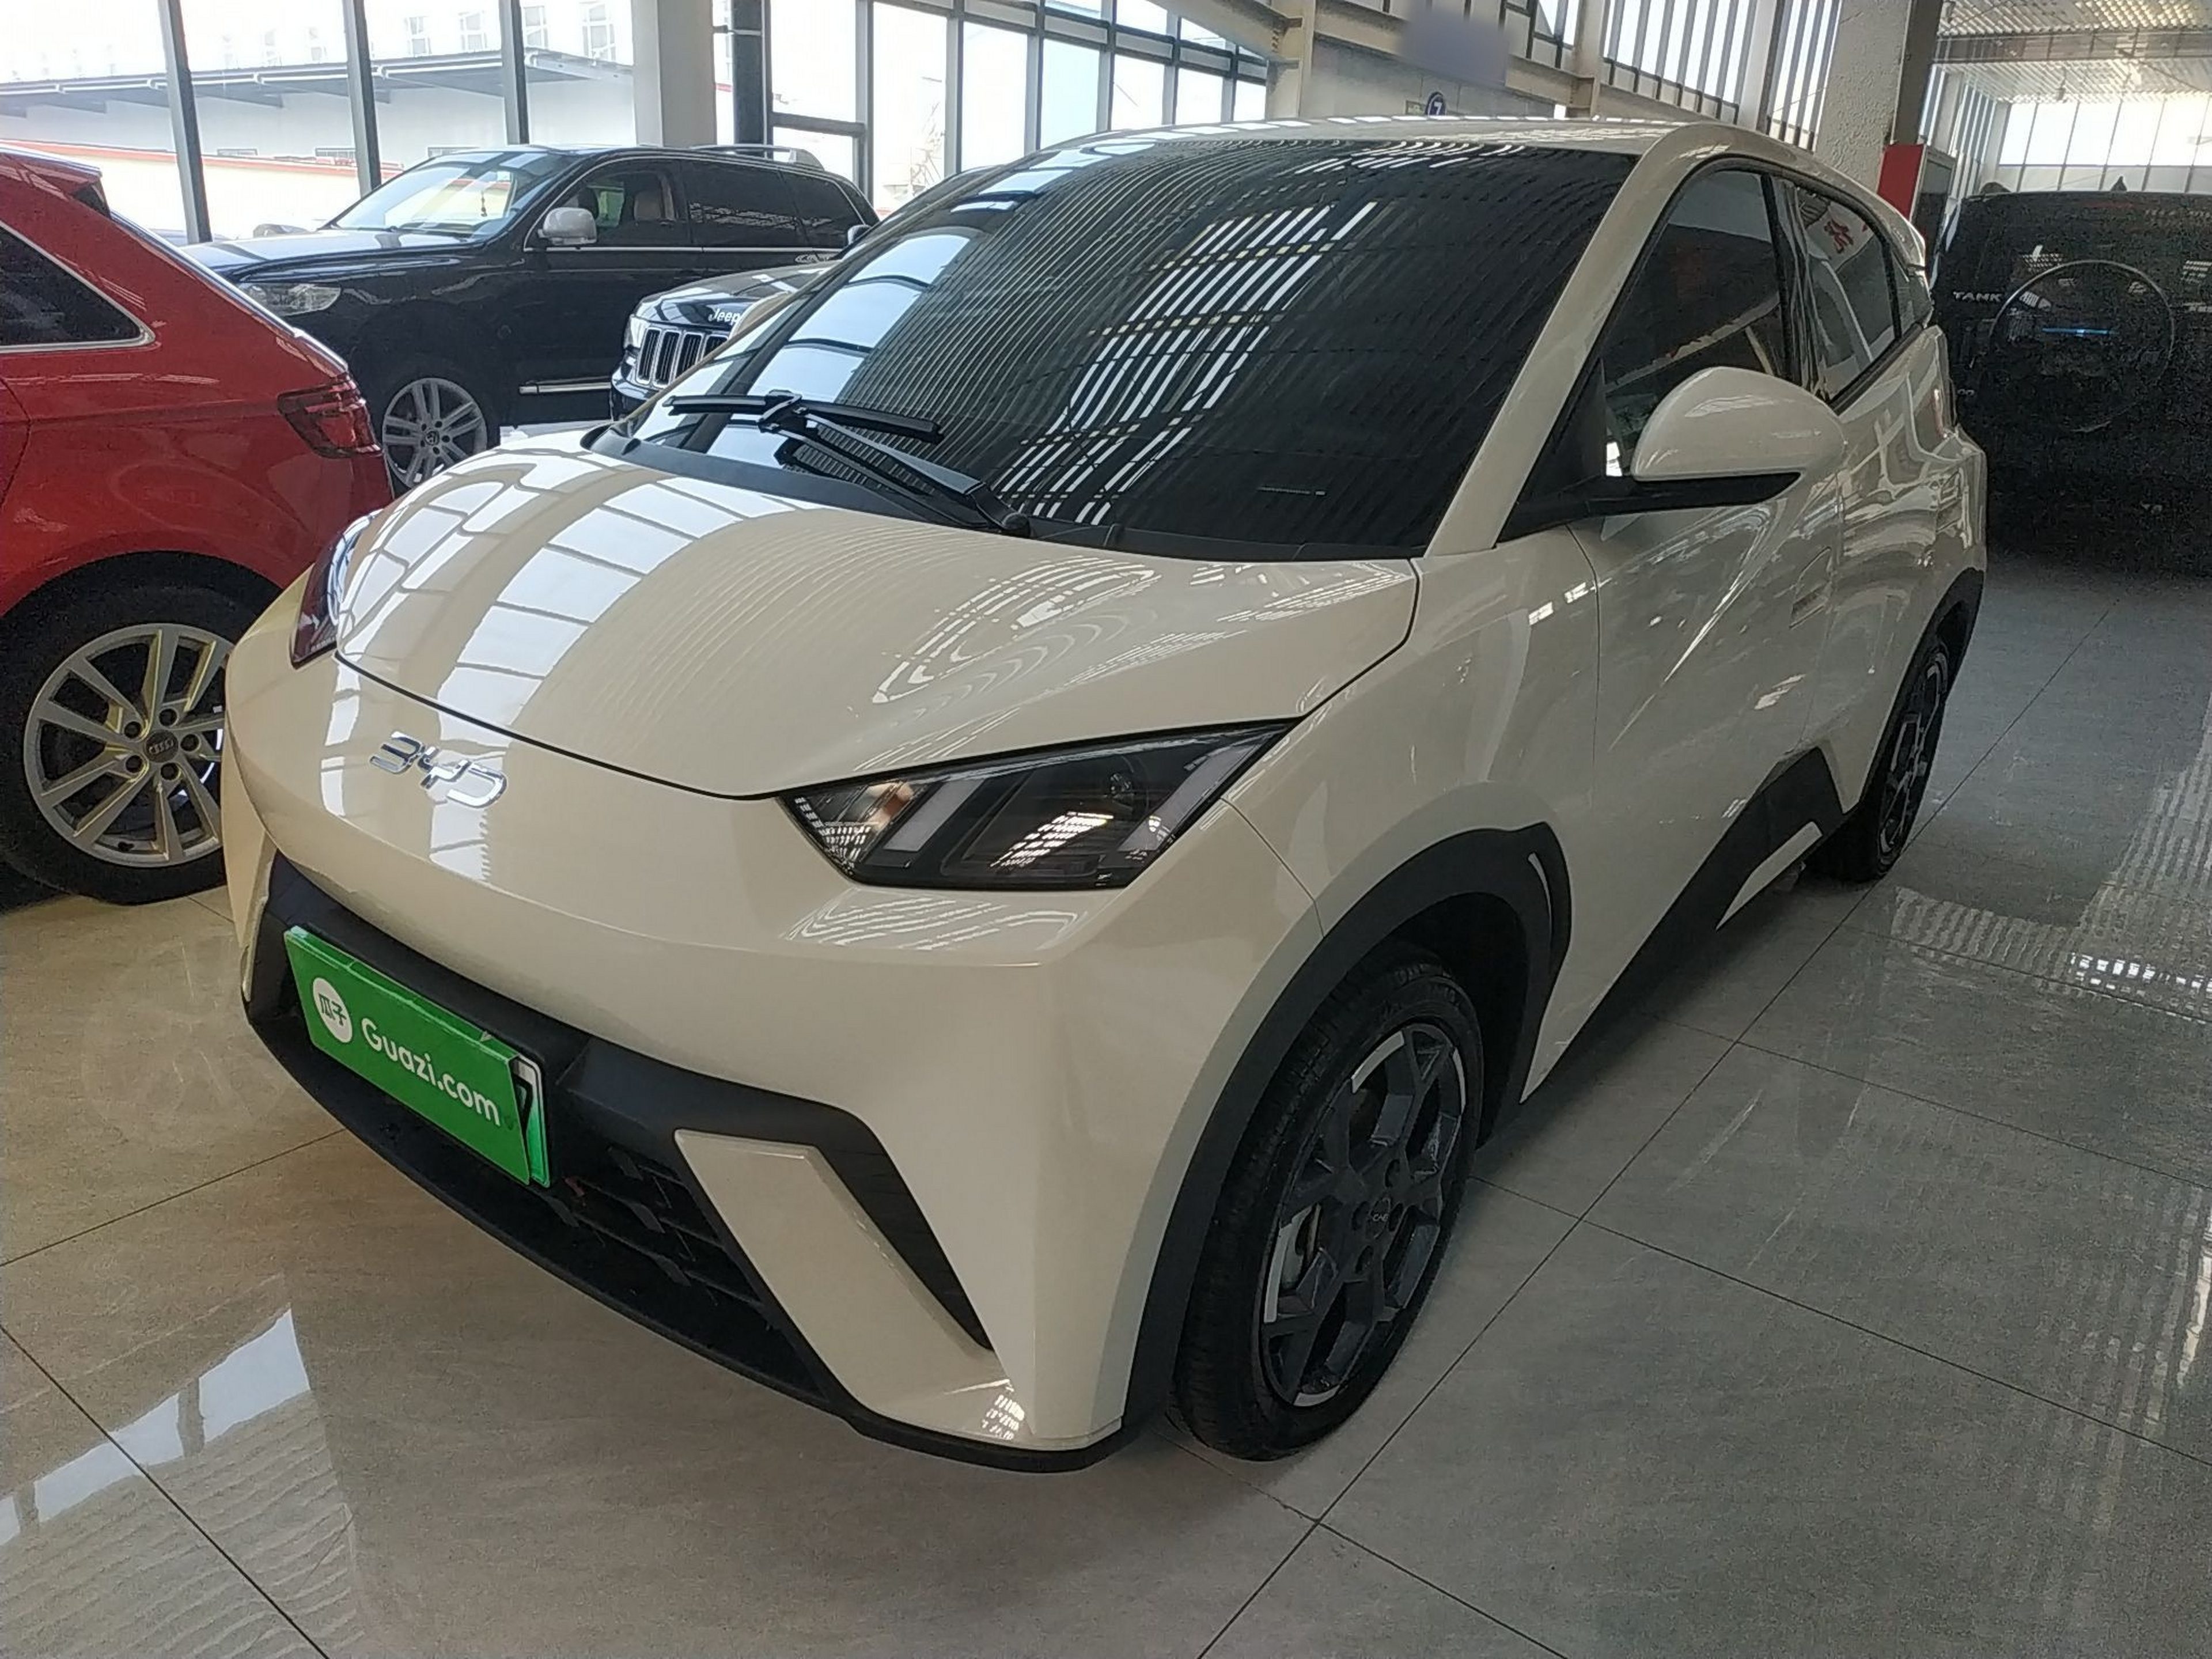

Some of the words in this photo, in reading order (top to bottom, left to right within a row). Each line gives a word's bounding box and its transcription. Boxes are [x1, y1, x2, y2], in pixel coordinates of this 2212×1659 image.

[1953, 291, 2003, 302] TANK
[708, 308, 741, 326] Jeep
[369, 730, 507, 809] BYD
[319, 993, 347, 1026] 瓜子
[361, 1018, 501, 1127] Guazi.com
